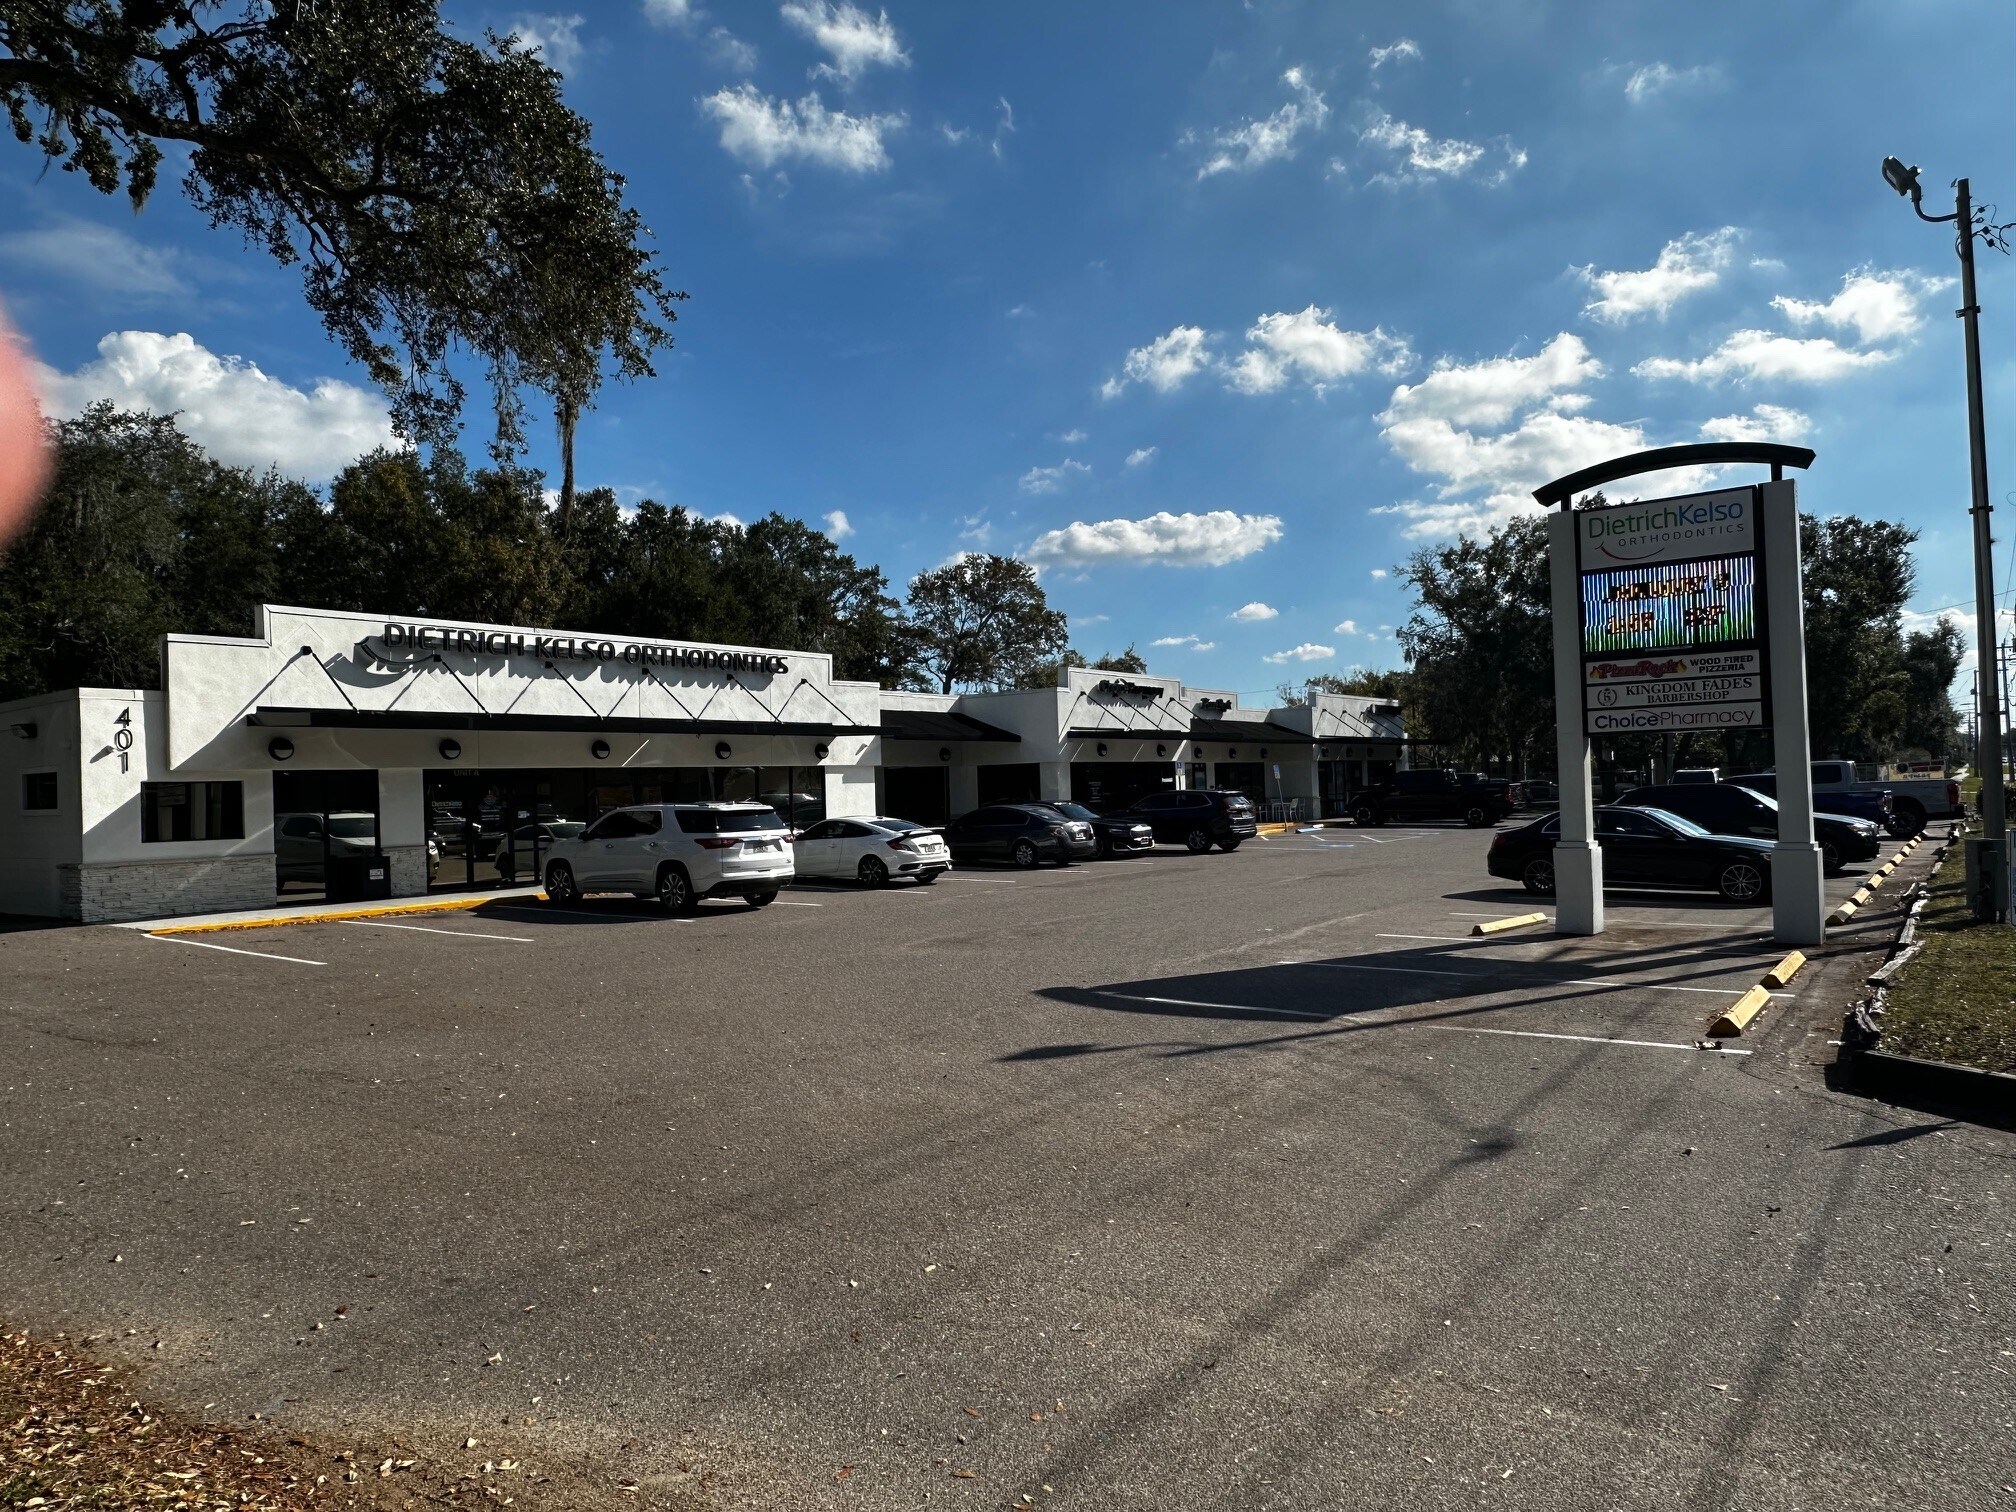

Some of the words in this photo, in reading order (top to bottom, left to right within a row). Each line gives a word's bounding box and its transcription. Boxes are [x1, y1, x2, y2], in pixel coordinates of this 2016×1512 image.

[1588, 501, 1744, 538] DietrichKelso
[1618, 523, 1745, 547] ORTHODONTICS
[384, 624, 524, 656] DIETRICH
[535, 636, 616, 662] KELSO
[624, 643, 789, 674] ORTHODONTICS
[1690, 657, 1721, 667] WOOD
[1724, 655, 1754, 664] FIRED
[1699, 663, 1745, 673] PIZZERIA
[1626, 682, 1696, 696] KINGDOM
[1701, 677, 1753, 690] FADES
[1647, 690, 1730, 704] BARBERSHOP
[116, 706, 133, 772] 401
